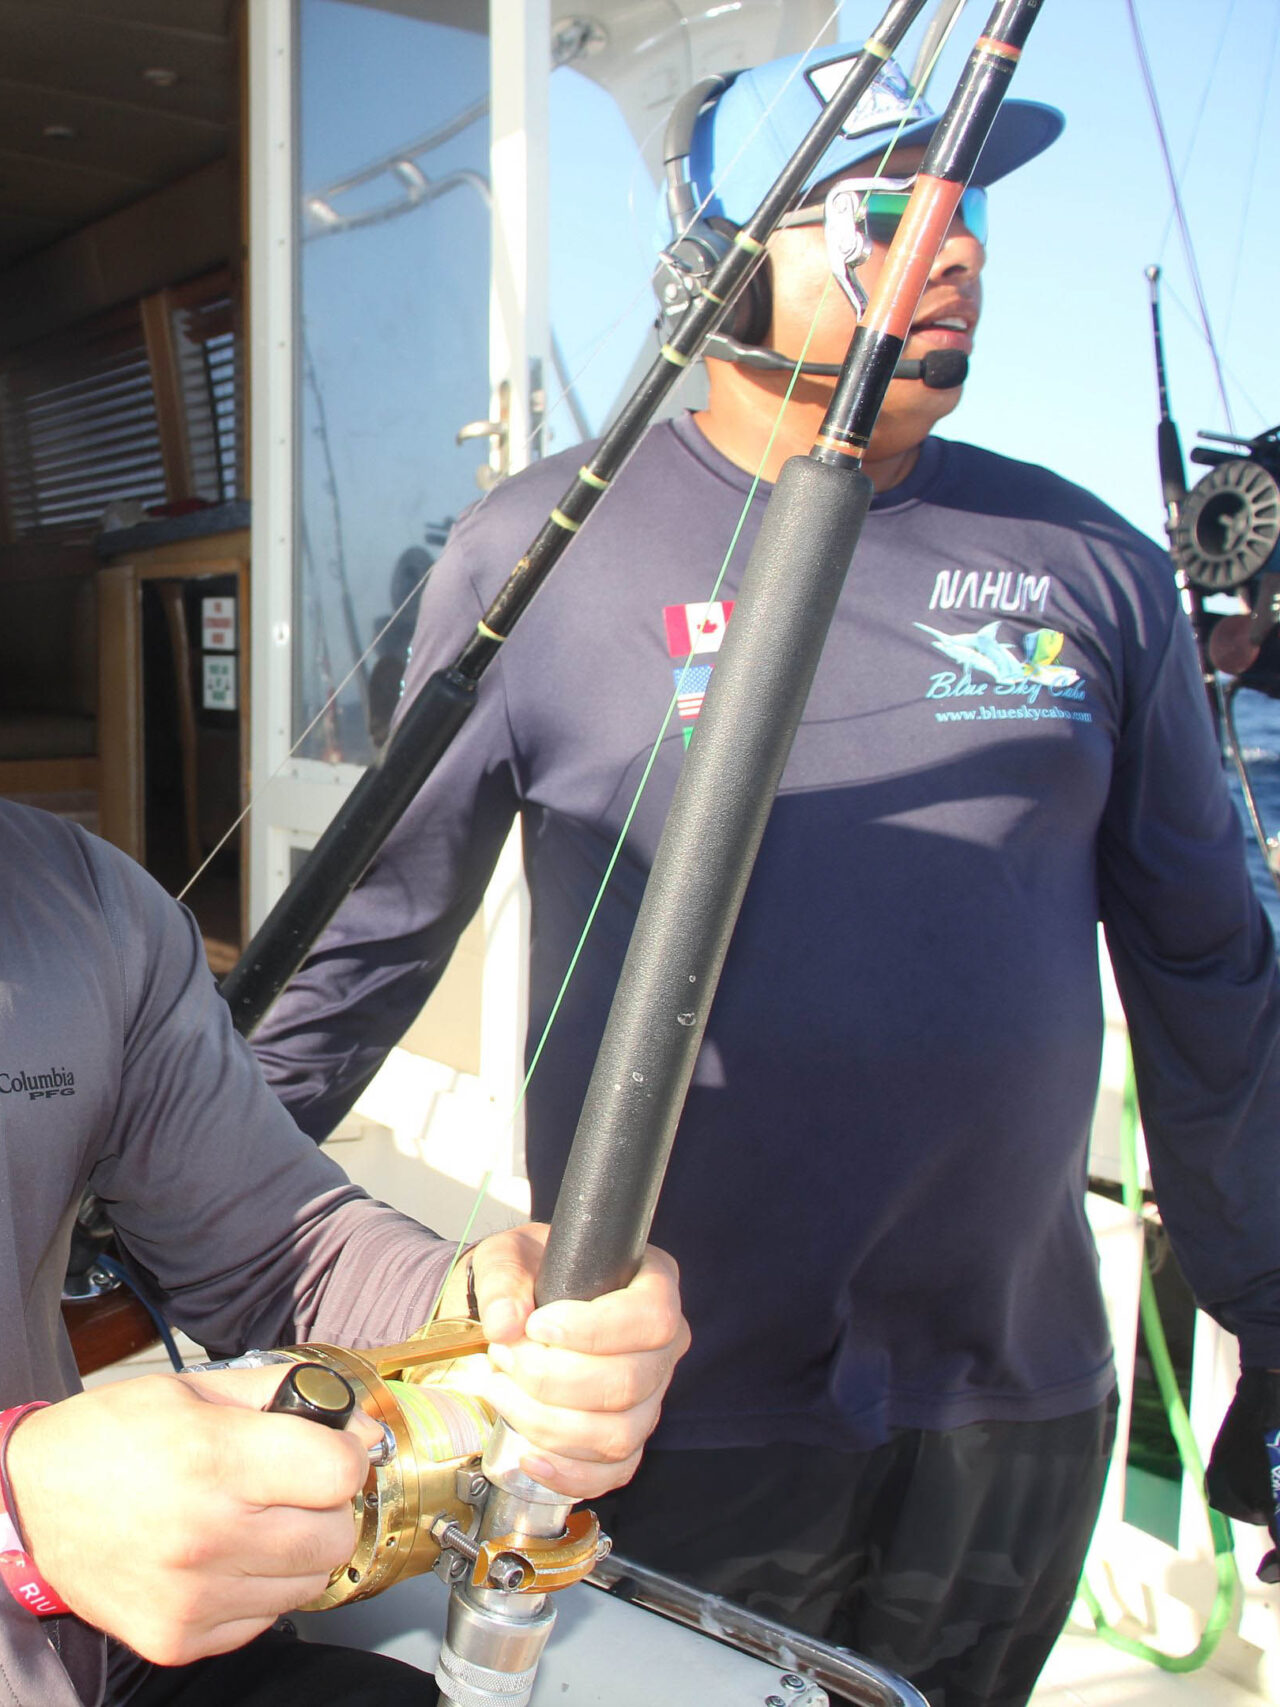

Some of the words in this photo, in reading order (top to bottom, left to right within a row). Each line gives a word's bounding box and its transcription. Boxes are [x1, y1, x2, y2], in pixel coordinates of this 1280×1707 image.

[929, 570, 1051, 612] NAHUM
[925, 671, 988, 699] Blue
[993, 677, 1042, 704] Sky
[935, 704, 1092, 722] www.blueskycabo.com
[29, 1087, 75, 1101] PFG
[19, 1581, 57, 1613] RIU
